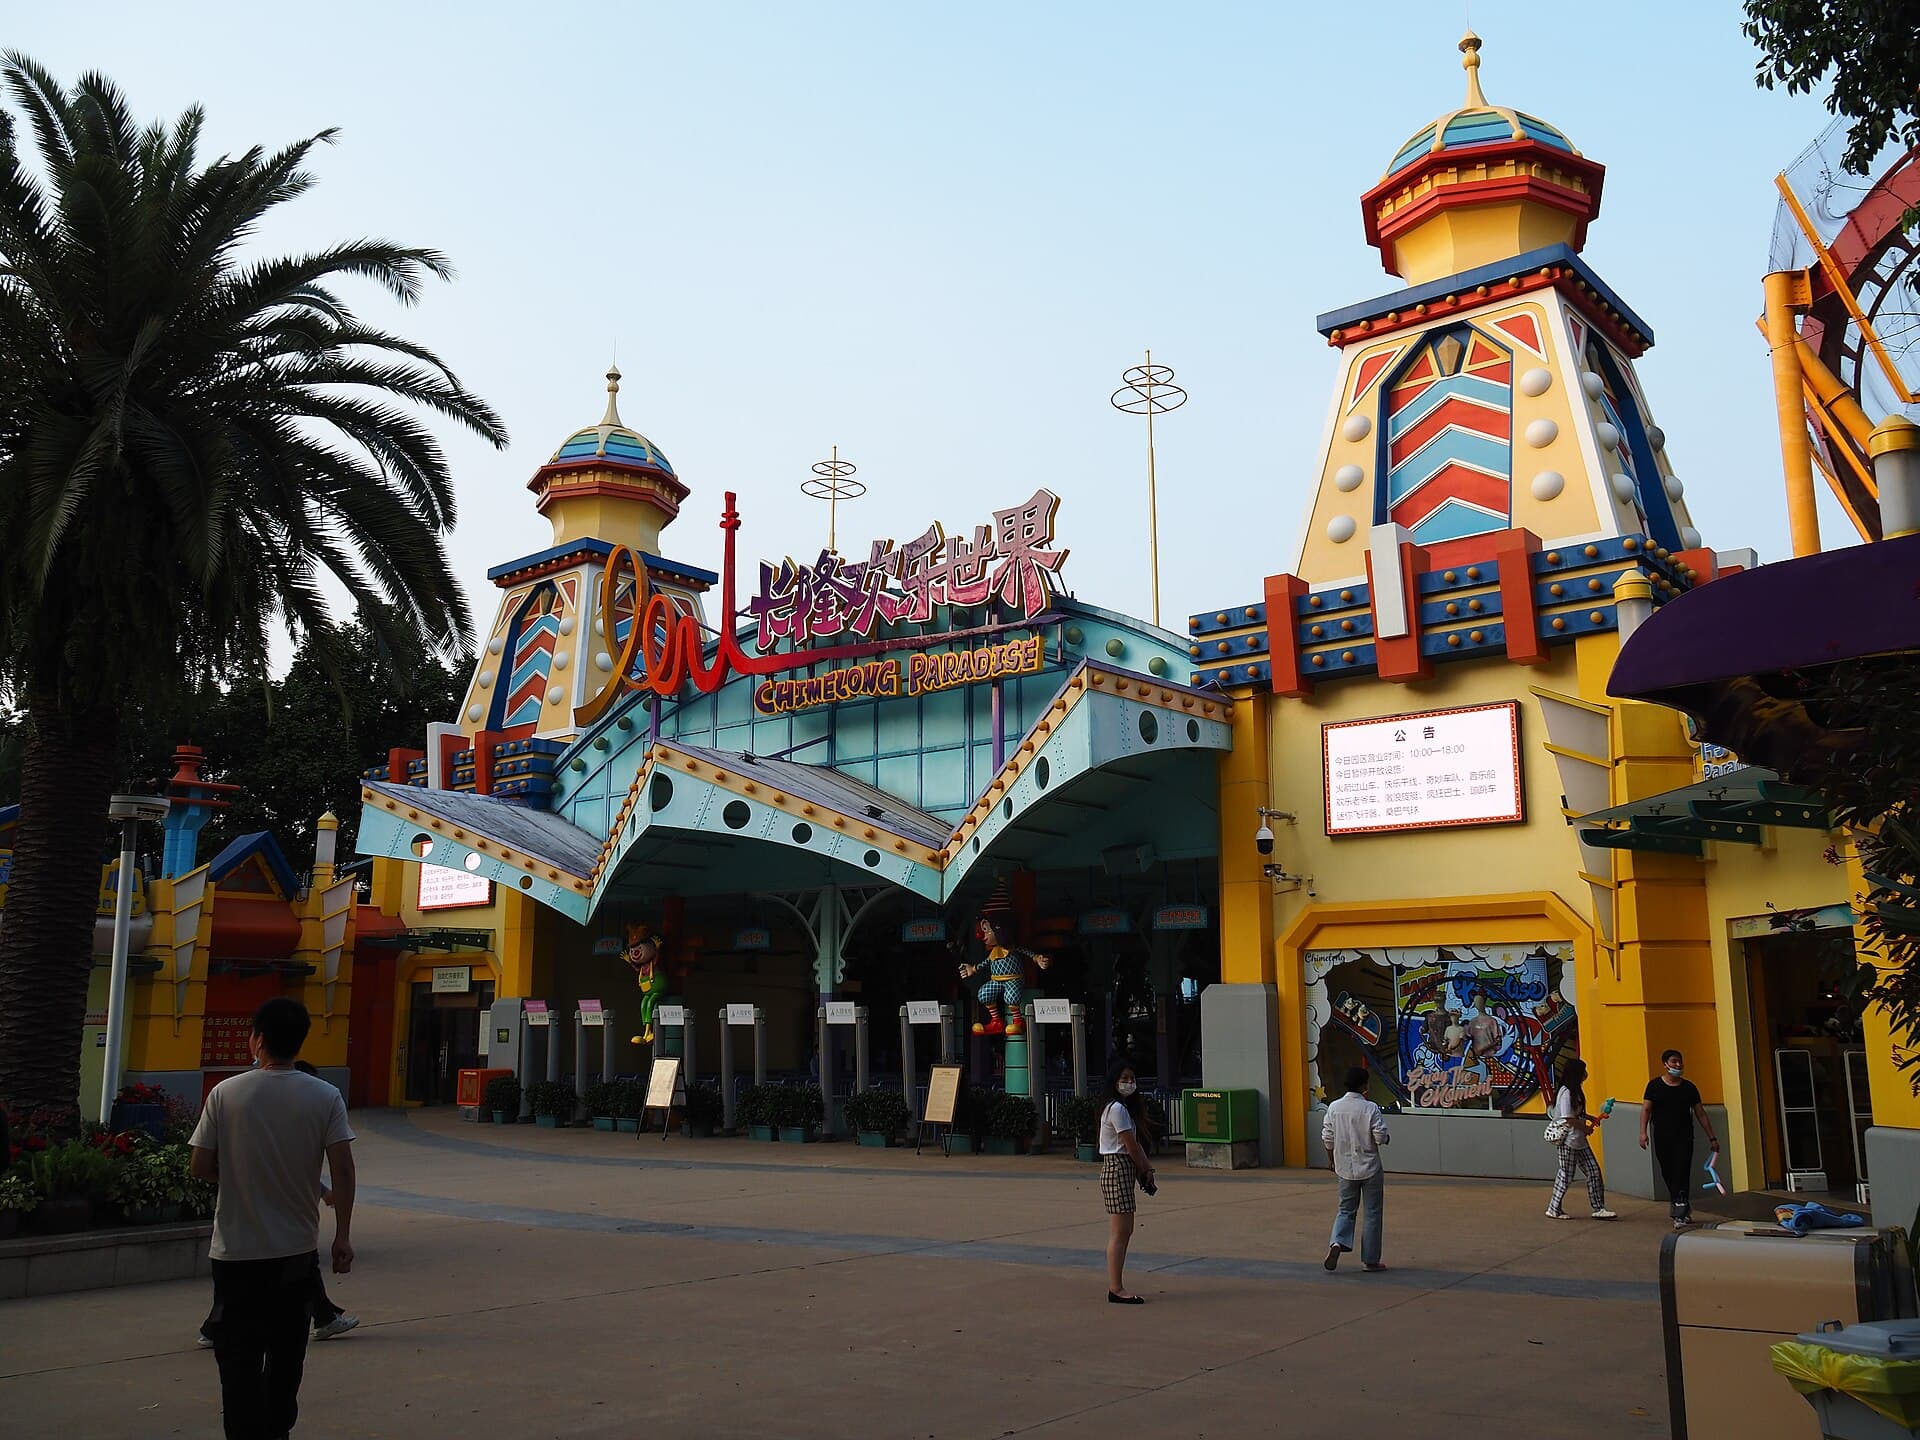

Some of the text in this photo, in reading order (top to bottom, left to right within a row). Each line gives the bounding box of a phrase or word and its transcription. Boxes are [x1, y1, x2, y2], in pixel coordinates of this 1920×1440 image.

[751, 488, 1070, 652] 长隆欢乐世界
[754, 635, 1044, 715] CHIMELONG PARADISE
[462, 1077, 477, 1099] M
[1406, 1066, 1472, 1092] Enjoy The
[1420, 1075, 1493, 1108] Moment
[1192, 1091, 1221, 1099] CHIMELONG
[1197, 1103, 1218, 1134] E
